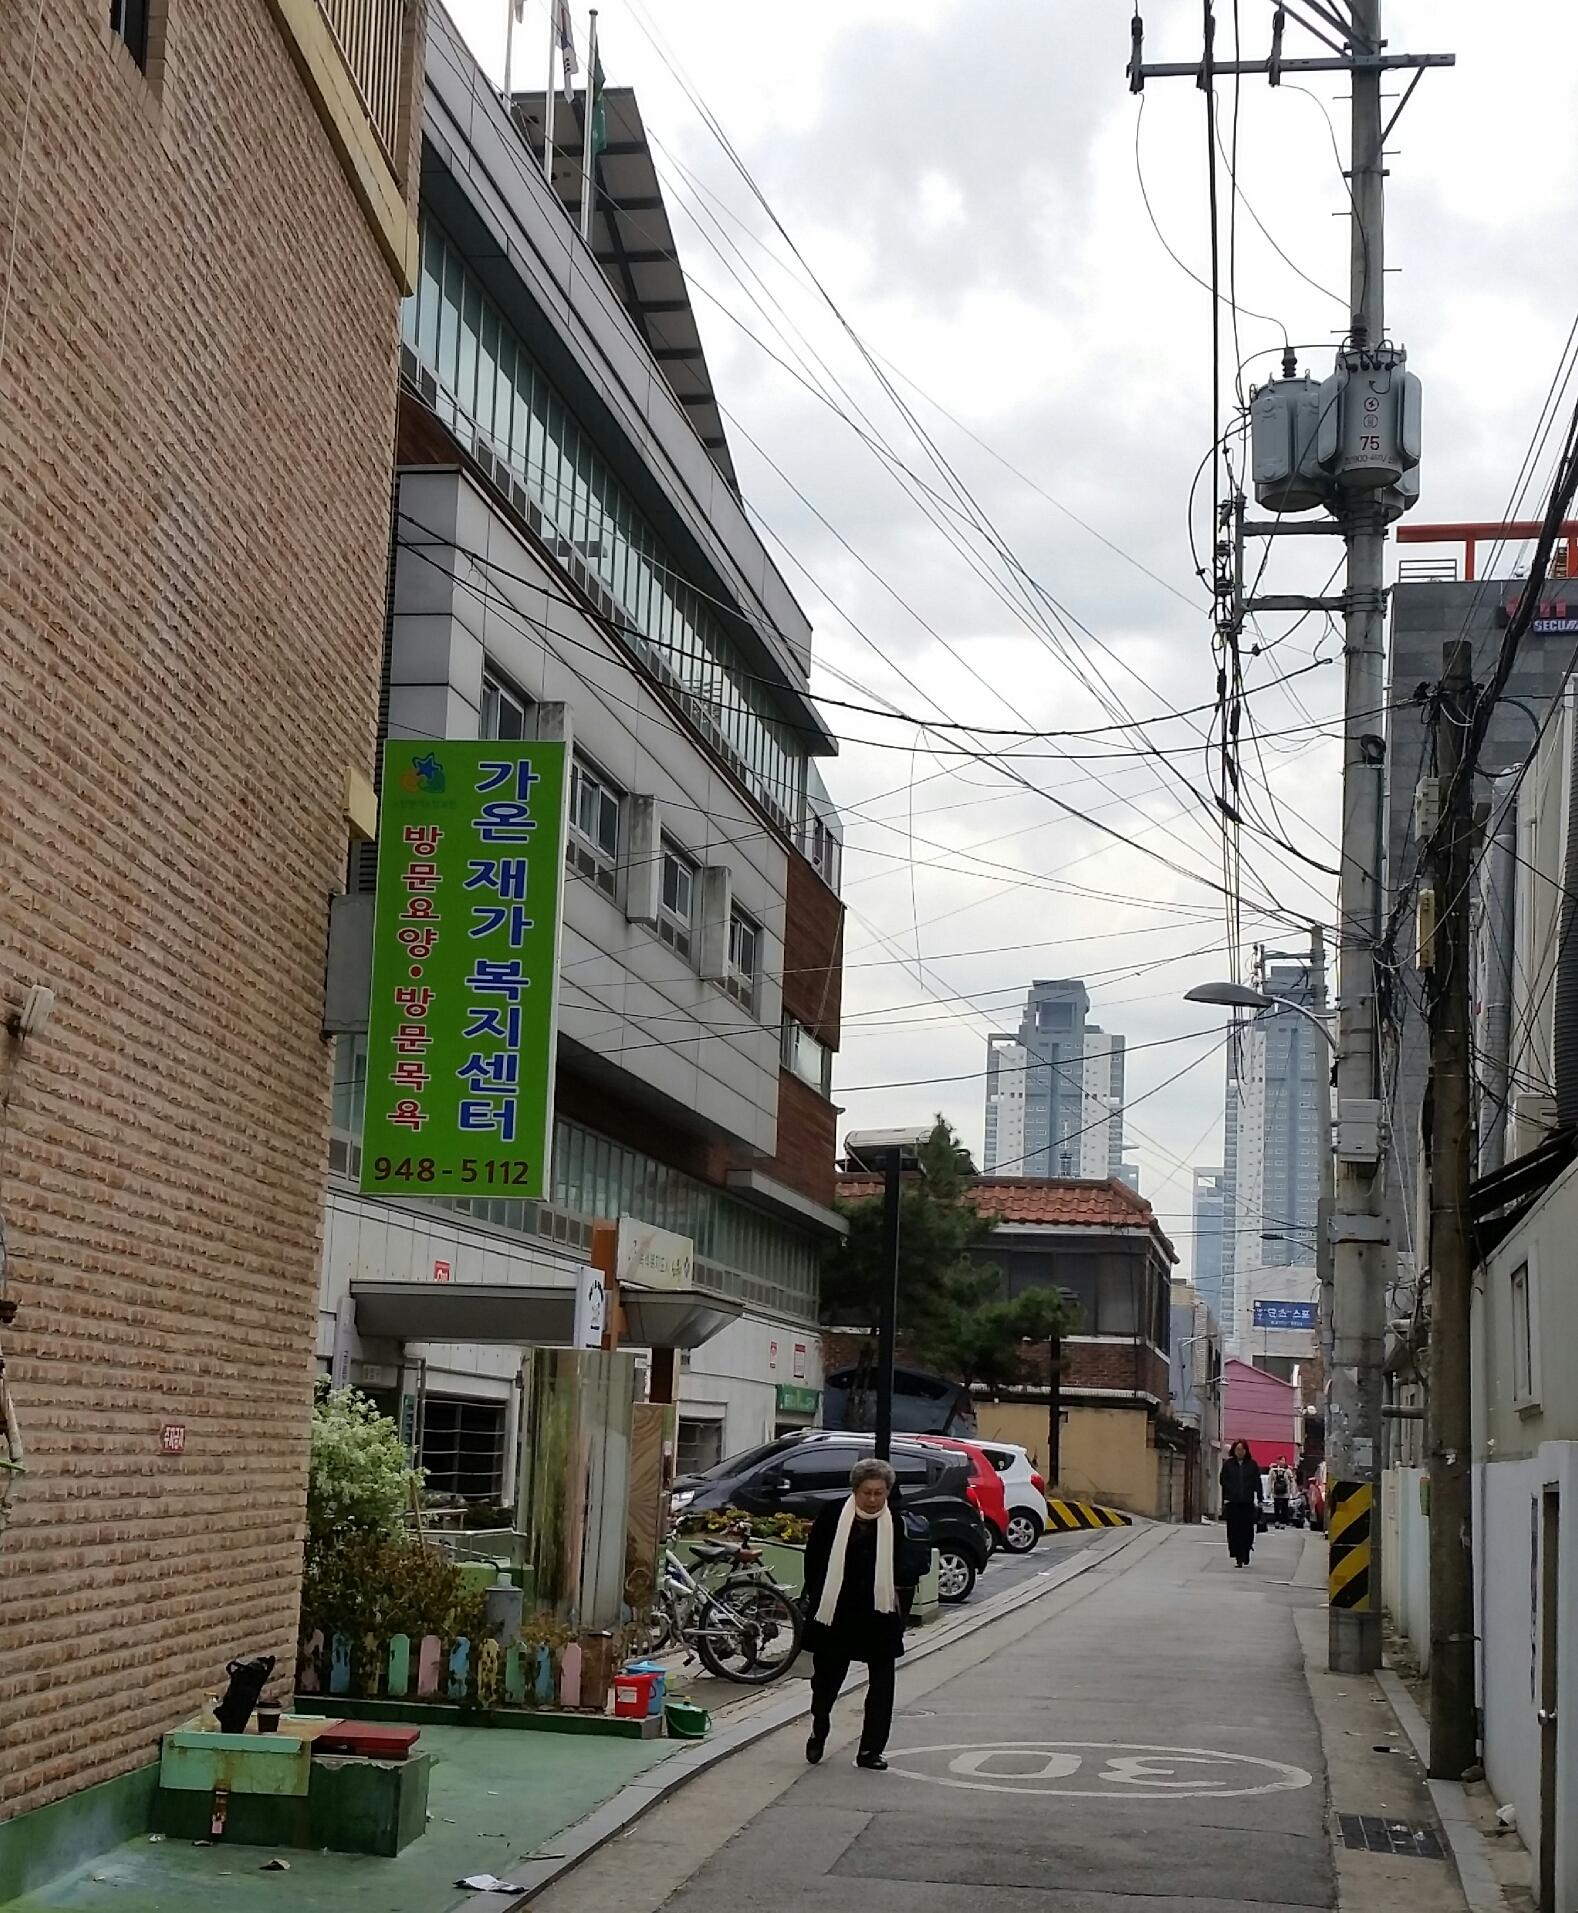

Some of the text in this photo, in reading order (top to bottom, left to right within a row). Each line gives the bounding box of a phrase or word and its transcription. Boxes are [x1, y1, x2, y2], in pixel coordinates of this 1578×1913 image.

[1360, 435, 1380, 451] 75
[456, 758, 541, 1143] 가온 재가 복지센터
[373, 1156, 530, 1185] 948-5112
[948, 1749, 1238, 1788] 30
